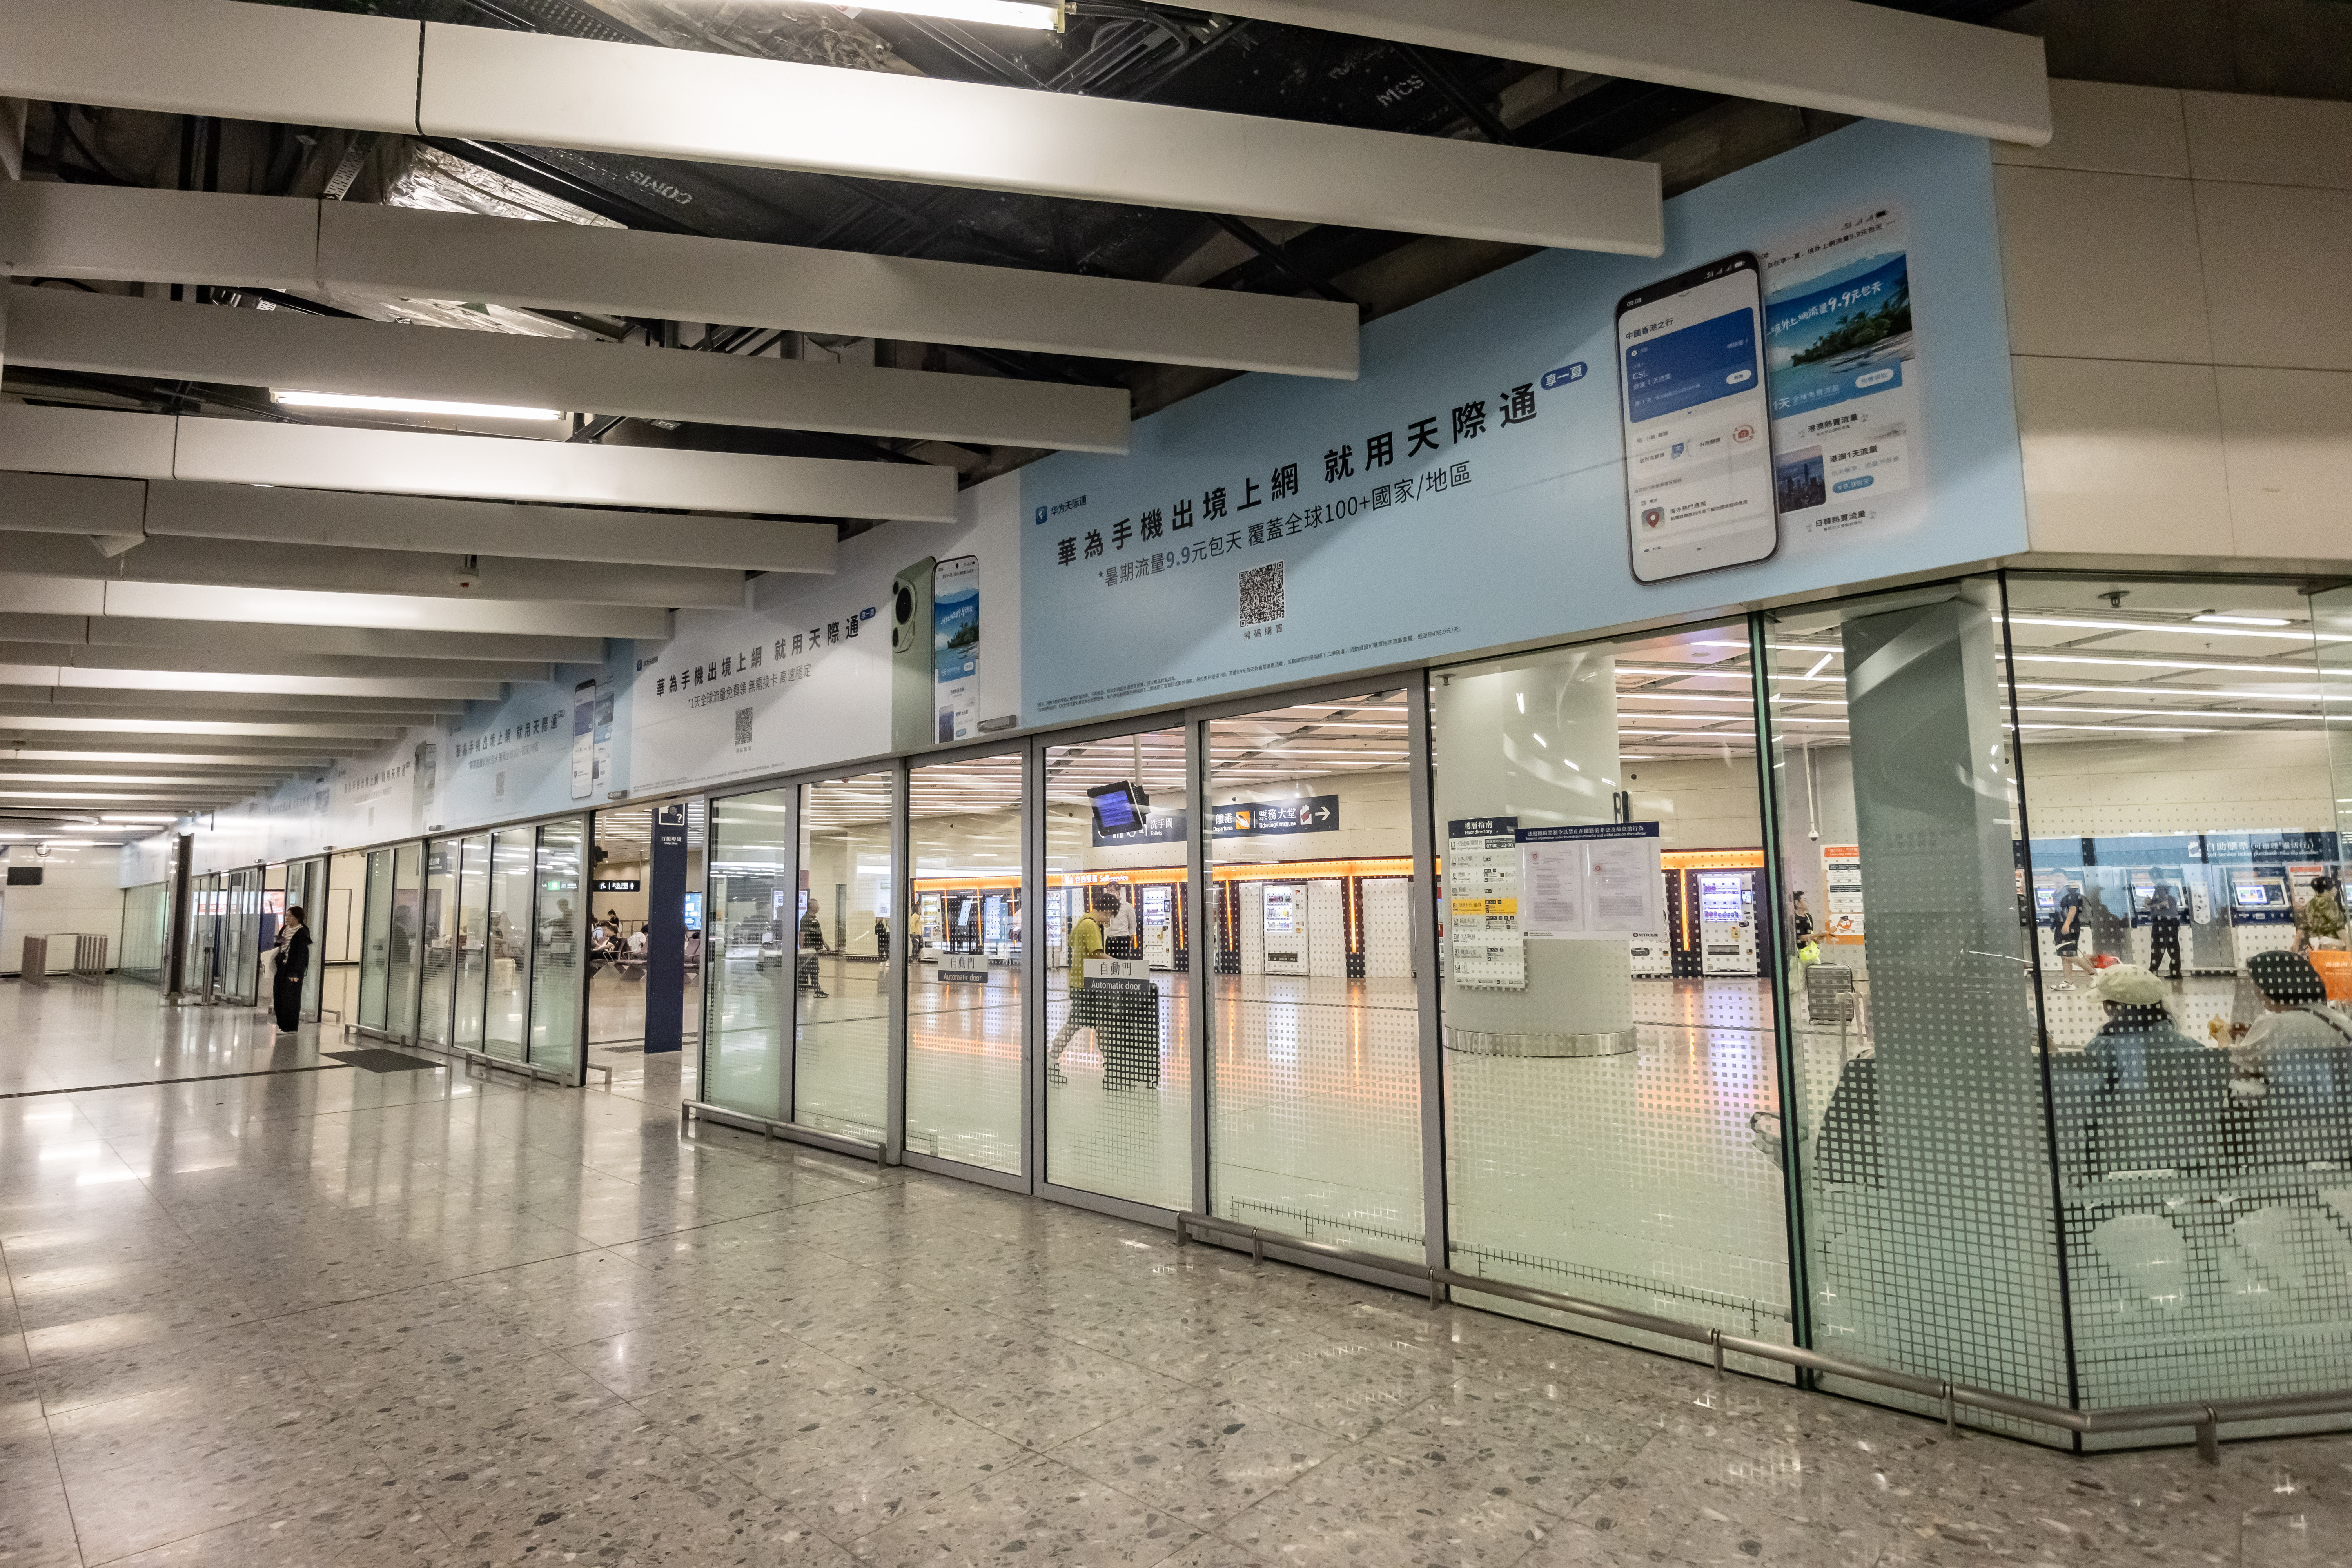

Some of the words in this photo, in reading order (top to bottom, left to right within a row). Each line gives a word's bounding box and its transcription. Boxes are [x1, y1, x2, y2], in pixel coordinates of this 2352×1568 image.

[1626, 318, 1673, 340] 中國香港之行
[1546, 365, 1583, 387] 享一夏
[1632, 371, 1648, 380] CSL
[1829, 445, 1878, 463] 港澳1天流量
[1057, 463, 1298, 568] 華為手機出境上網
[1323, 382, 1537, 484] 就用天際通
[1051, 495, 1087, 517] 华为天际通
[1248, 460, 1472, 547] 覆蓋全球100+國家/地區
[1243, 624, 1283, 641] 掃碼購買
[656, 646, 763, 698] 華為手機出境上網
[775, 614, 860, 661] 就用天際通
[748, 672, 777, 695] 無需換卡
[779, 662, 812, 685] 高速穩定
[516, 713, 557, 740] 就用天際通
[1150, 817, 1173, 829] 洗手間
[1215, 812, 1233, 825] 離港
[1258, 808, 1296, 821] 票務大堂
[1465, 820, 1492, 830] 樓層指南
[1075, 875, 1098, 884] 自助服務
[1099, 874, 1129, 882] Self-service
[950, 956, 975, 969] 自動門
[1099, 961, 1132, 976] 自動門
[944, 973, 969, 981] Automatic
[1091, 980, 1124, 990] Automatic
[1125, 981, 1141, 991] door
